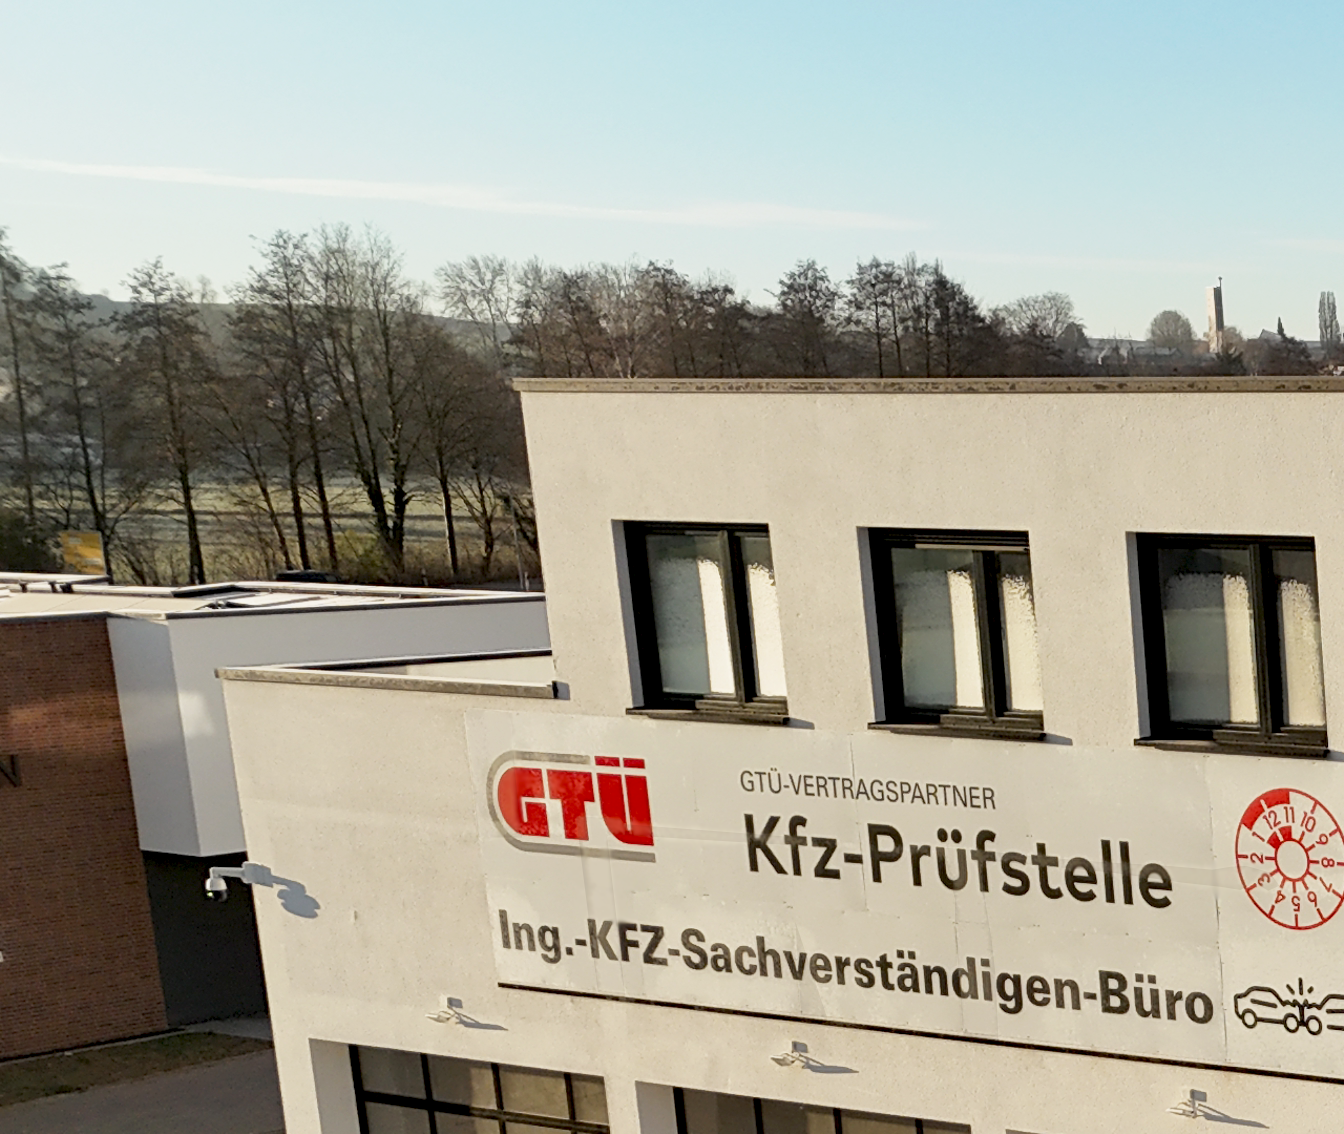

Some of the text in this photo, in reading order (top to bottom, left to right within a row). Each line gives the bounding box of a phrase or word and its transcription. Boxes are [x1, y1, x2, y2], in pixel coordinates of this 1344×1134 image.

[739, 767, 997, 810] GTÜ-VERTRAGSPARTNER
[497, 755, 655, 846] GTÜ
[1262, 809, 1281, 830] 12
[1283, 806, 1295, 823] 11
[1300, 811, 1316, 832] 10
[1251, 831, 1265, 842] 1
[1315, 833, 1329, 845] 9
[743, 812, 1173, 909] Kfz-Prüfstelle
[1250, 852, 1264, 864] 2
[1321, 857, 1335, 868] 8
[1257, 873, 1271, 887] 3
[1319, 876, 1333, 893] 7
[1274, 890, 1286, 904] 4
[1291, 895, 1301, 912] 5
[1307, 891, 1318, 908] 6
[499, 908, 1214, 1024] Ing.-KFZ-Sachverständigen-Büro
